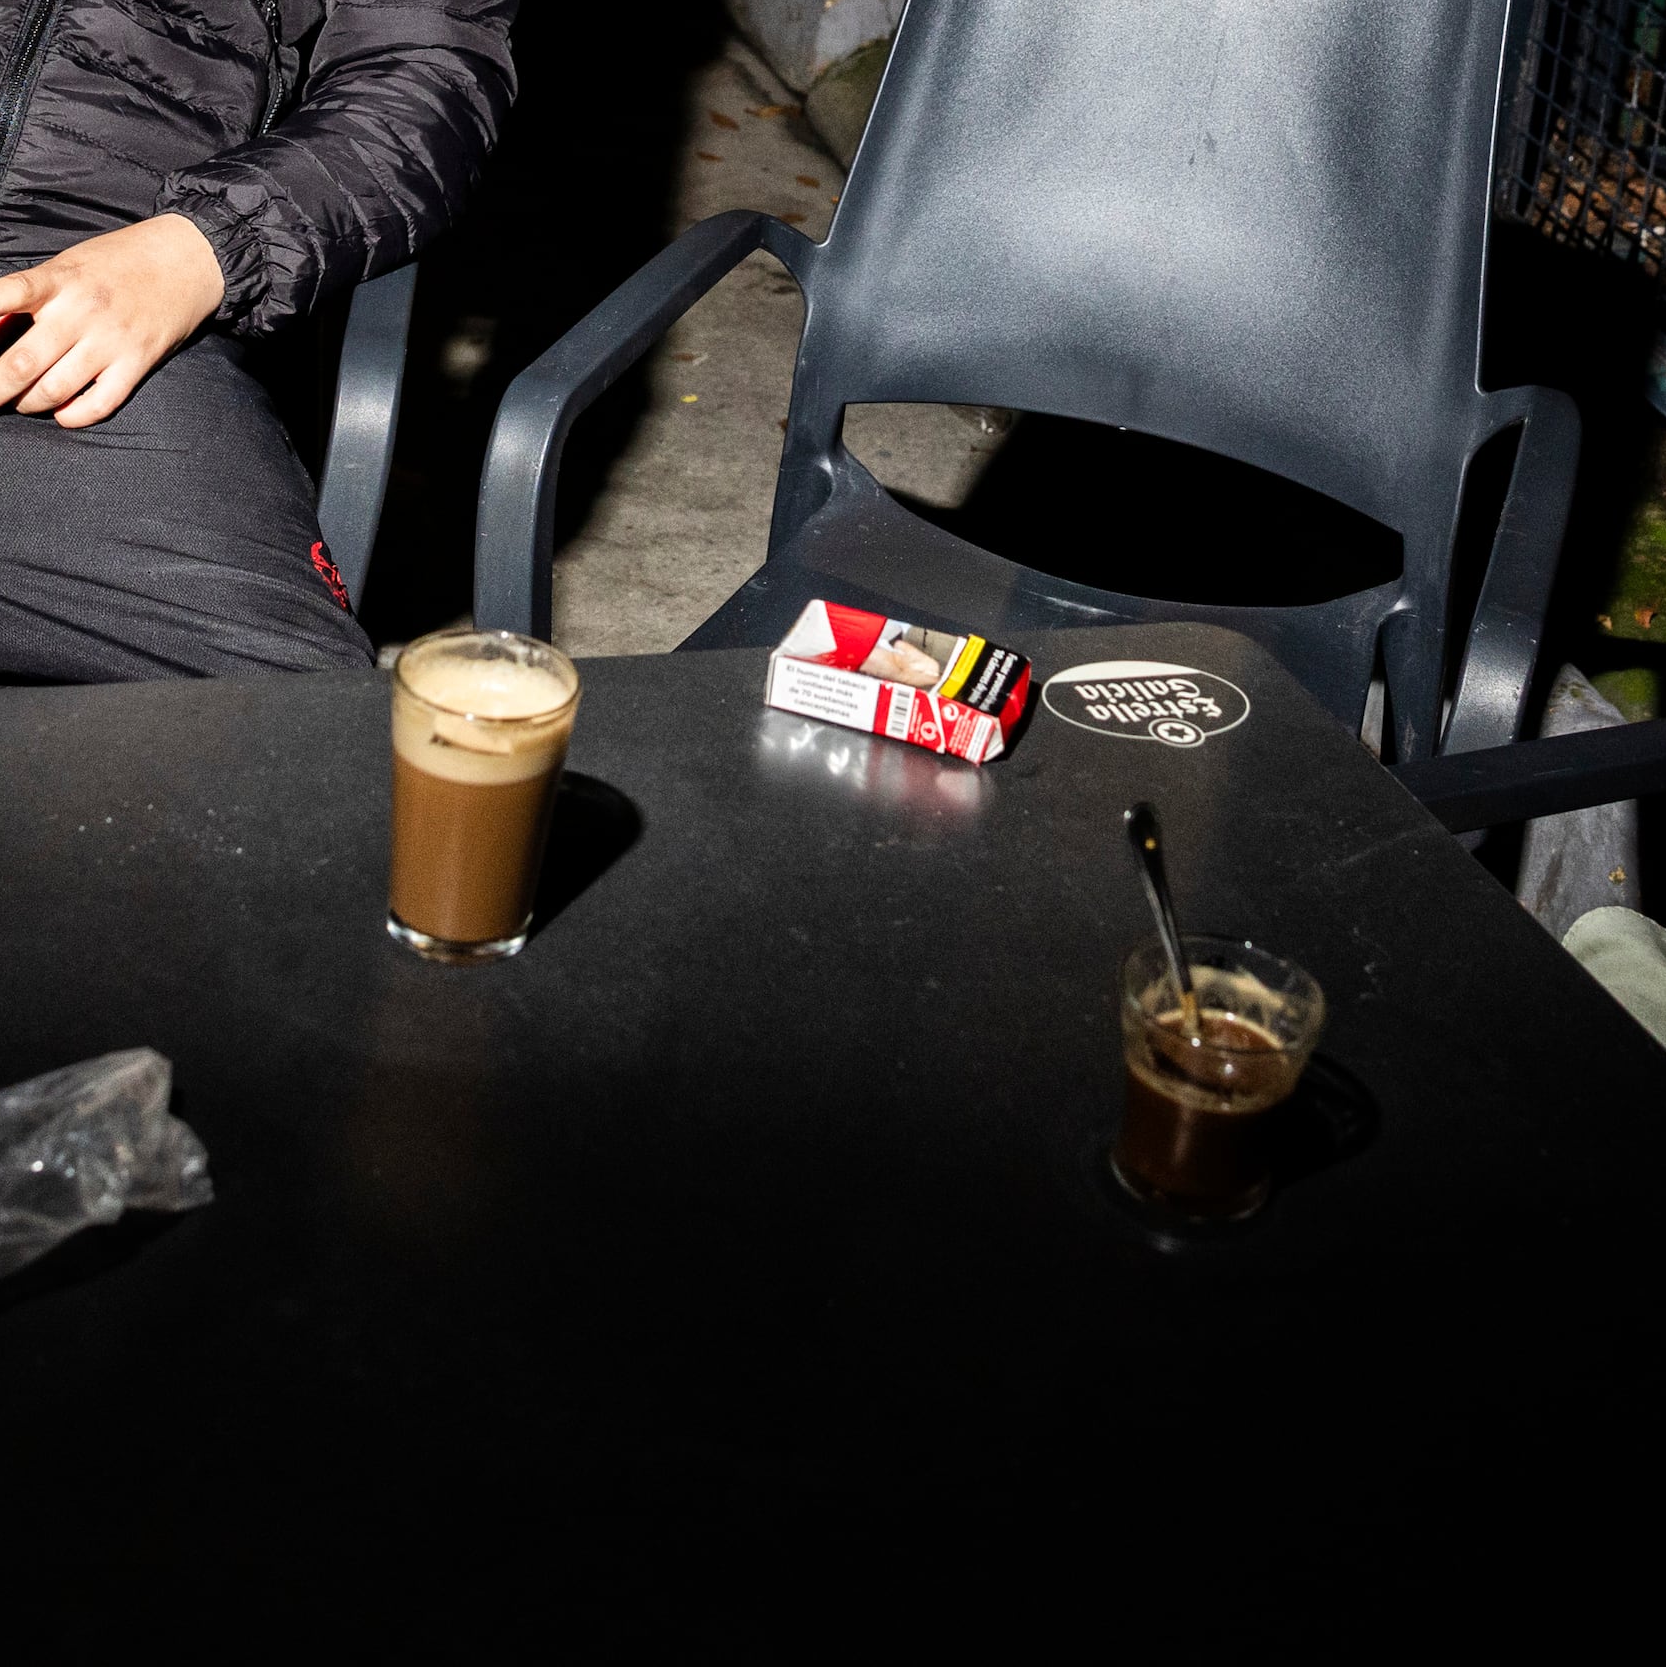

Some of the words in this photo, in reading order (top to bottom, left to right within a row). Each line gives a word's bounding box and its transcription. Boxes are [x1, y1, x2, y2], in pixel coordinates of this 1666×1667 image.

[786, 664, 794, 672] El
[796, 667, 820, 678] humo
[838, 677, 866, 690] tabaco
[797, 678, 833, 692] contiene
[788, 685, 799, 694] de
[801, 688, 812, 697] 70
[814, 693, 858, 709] sustancias
[1074, 678, 1201, 701] Galicia
[1086, 696, 1223, 723] Estrella
